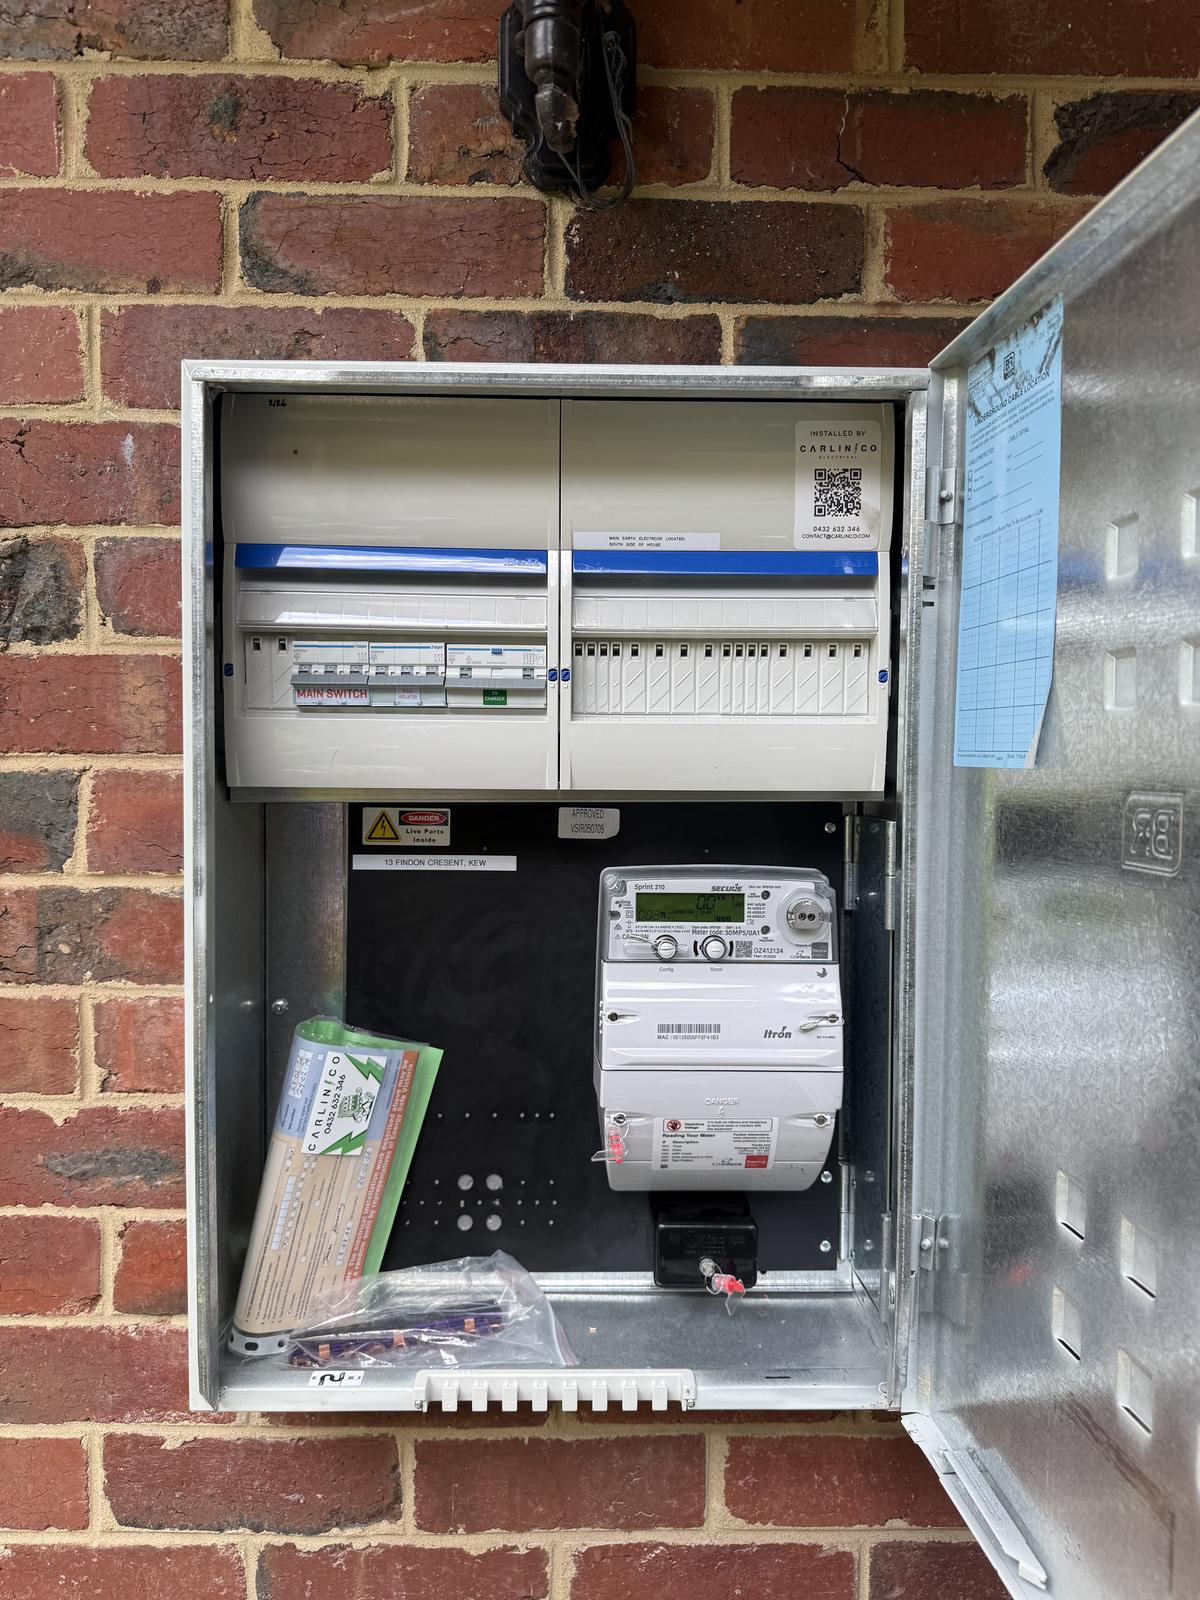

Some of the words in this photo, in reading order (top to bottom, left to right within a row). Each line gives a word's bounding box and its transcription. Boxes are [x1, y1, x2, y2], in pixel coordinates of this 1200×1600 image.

[974, 399, 1008, 427] UNDERGROUND
[1008, 390, 1024, 404] CABLE
[1024, 370, 1050, 393] LOCATION
[297, 688, 324, 698] MAIN
[326, 689, 367, 699] SWITCH
[572, 809, 604, 818] APPROVED
[428, 859, 466, 867] CRESENT,
[323, 1110, 336, 1134] 0432
[330, 1091, 340, 1109] 632
[335, 1073, 346, 1091] 346
[354, 1215, 367, 1250] electrical
[363, 1171, 379, 1213] installation
[376, 1151, 385, 1168] work
[382, 1113, 395, 1149] described
[392, 1088, 401, 1110] above
[355, 1240, 366, 1269] random
[372, 1150, 391, 1206] representatives
[391, 1113, 401, 1138] Energy
